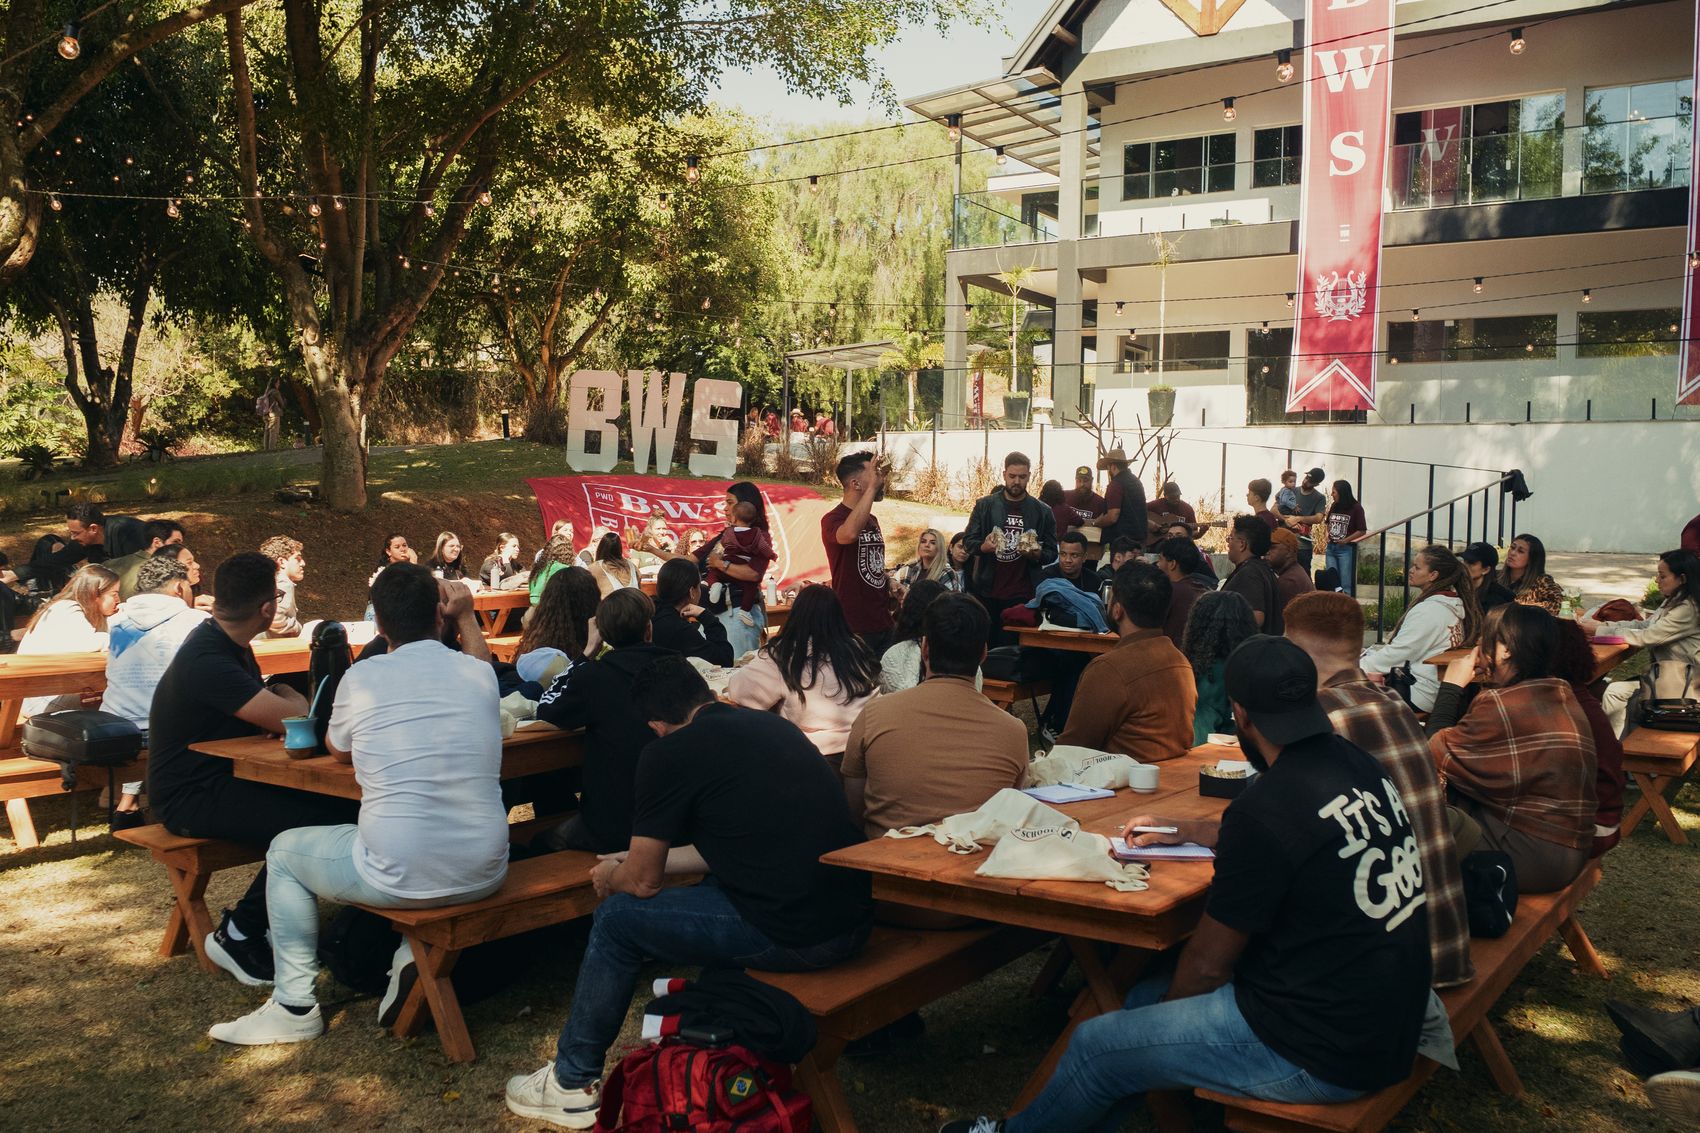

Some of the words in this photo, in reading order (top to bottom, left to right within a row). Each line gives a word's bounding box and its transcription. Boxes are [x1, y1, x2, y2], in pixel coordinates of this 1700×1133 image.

[1315, 0, 1386, 177] WS
[566, 369, 743, 479] BWS
[595, 491, 614, 502] PWD
[1318, 787, 1392, 859] IT'S
[1381, 777, 1411, 827] A
